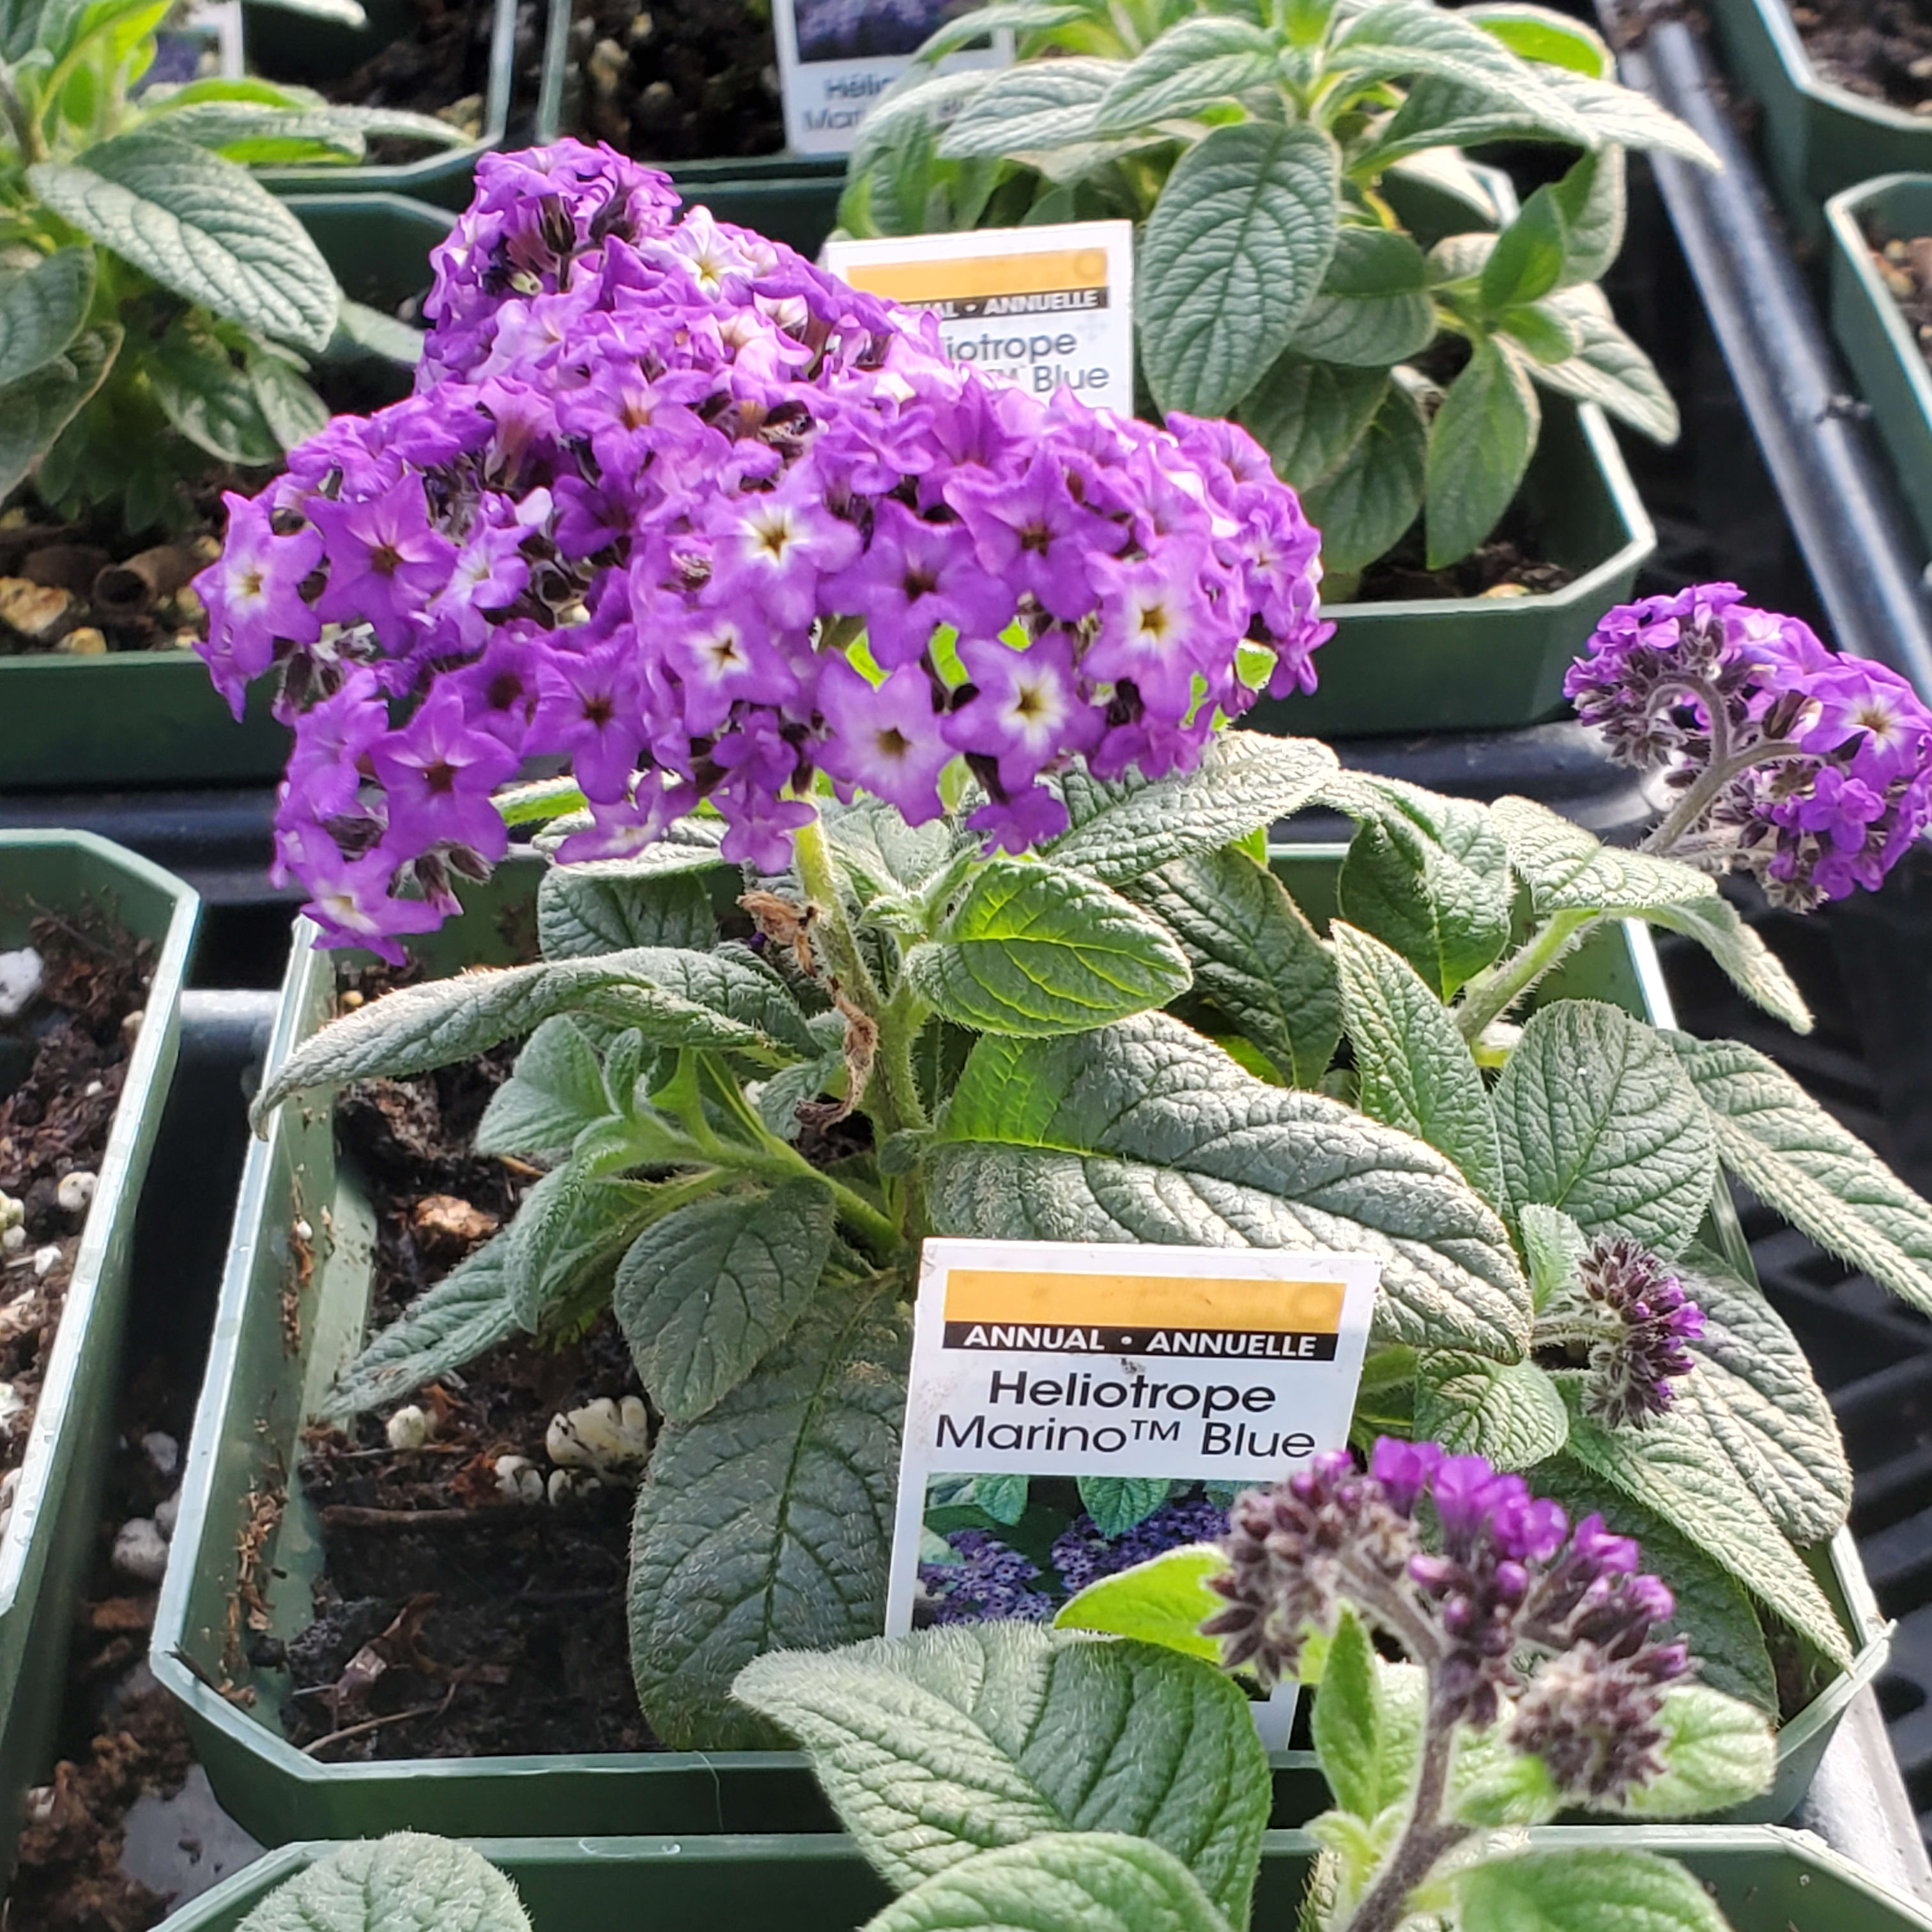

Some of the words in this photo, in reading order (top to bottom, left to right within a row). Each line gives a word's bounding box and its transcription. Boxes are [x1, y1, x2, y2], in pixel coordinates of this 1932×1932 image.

[983, 291, 1099, 316] ANNUELLE
[941, 332, 1077, 364] iotrope
[1034, 364, 1110, 393] Blue
[963, 1324, 1105, 1351] ANNUAL
[1146, 1331, 1317, 1357] ANNUELLE
[989, 1370, 1276, 1419] Heliotrope
[1201, 1422, 1315, 1459] Blue
